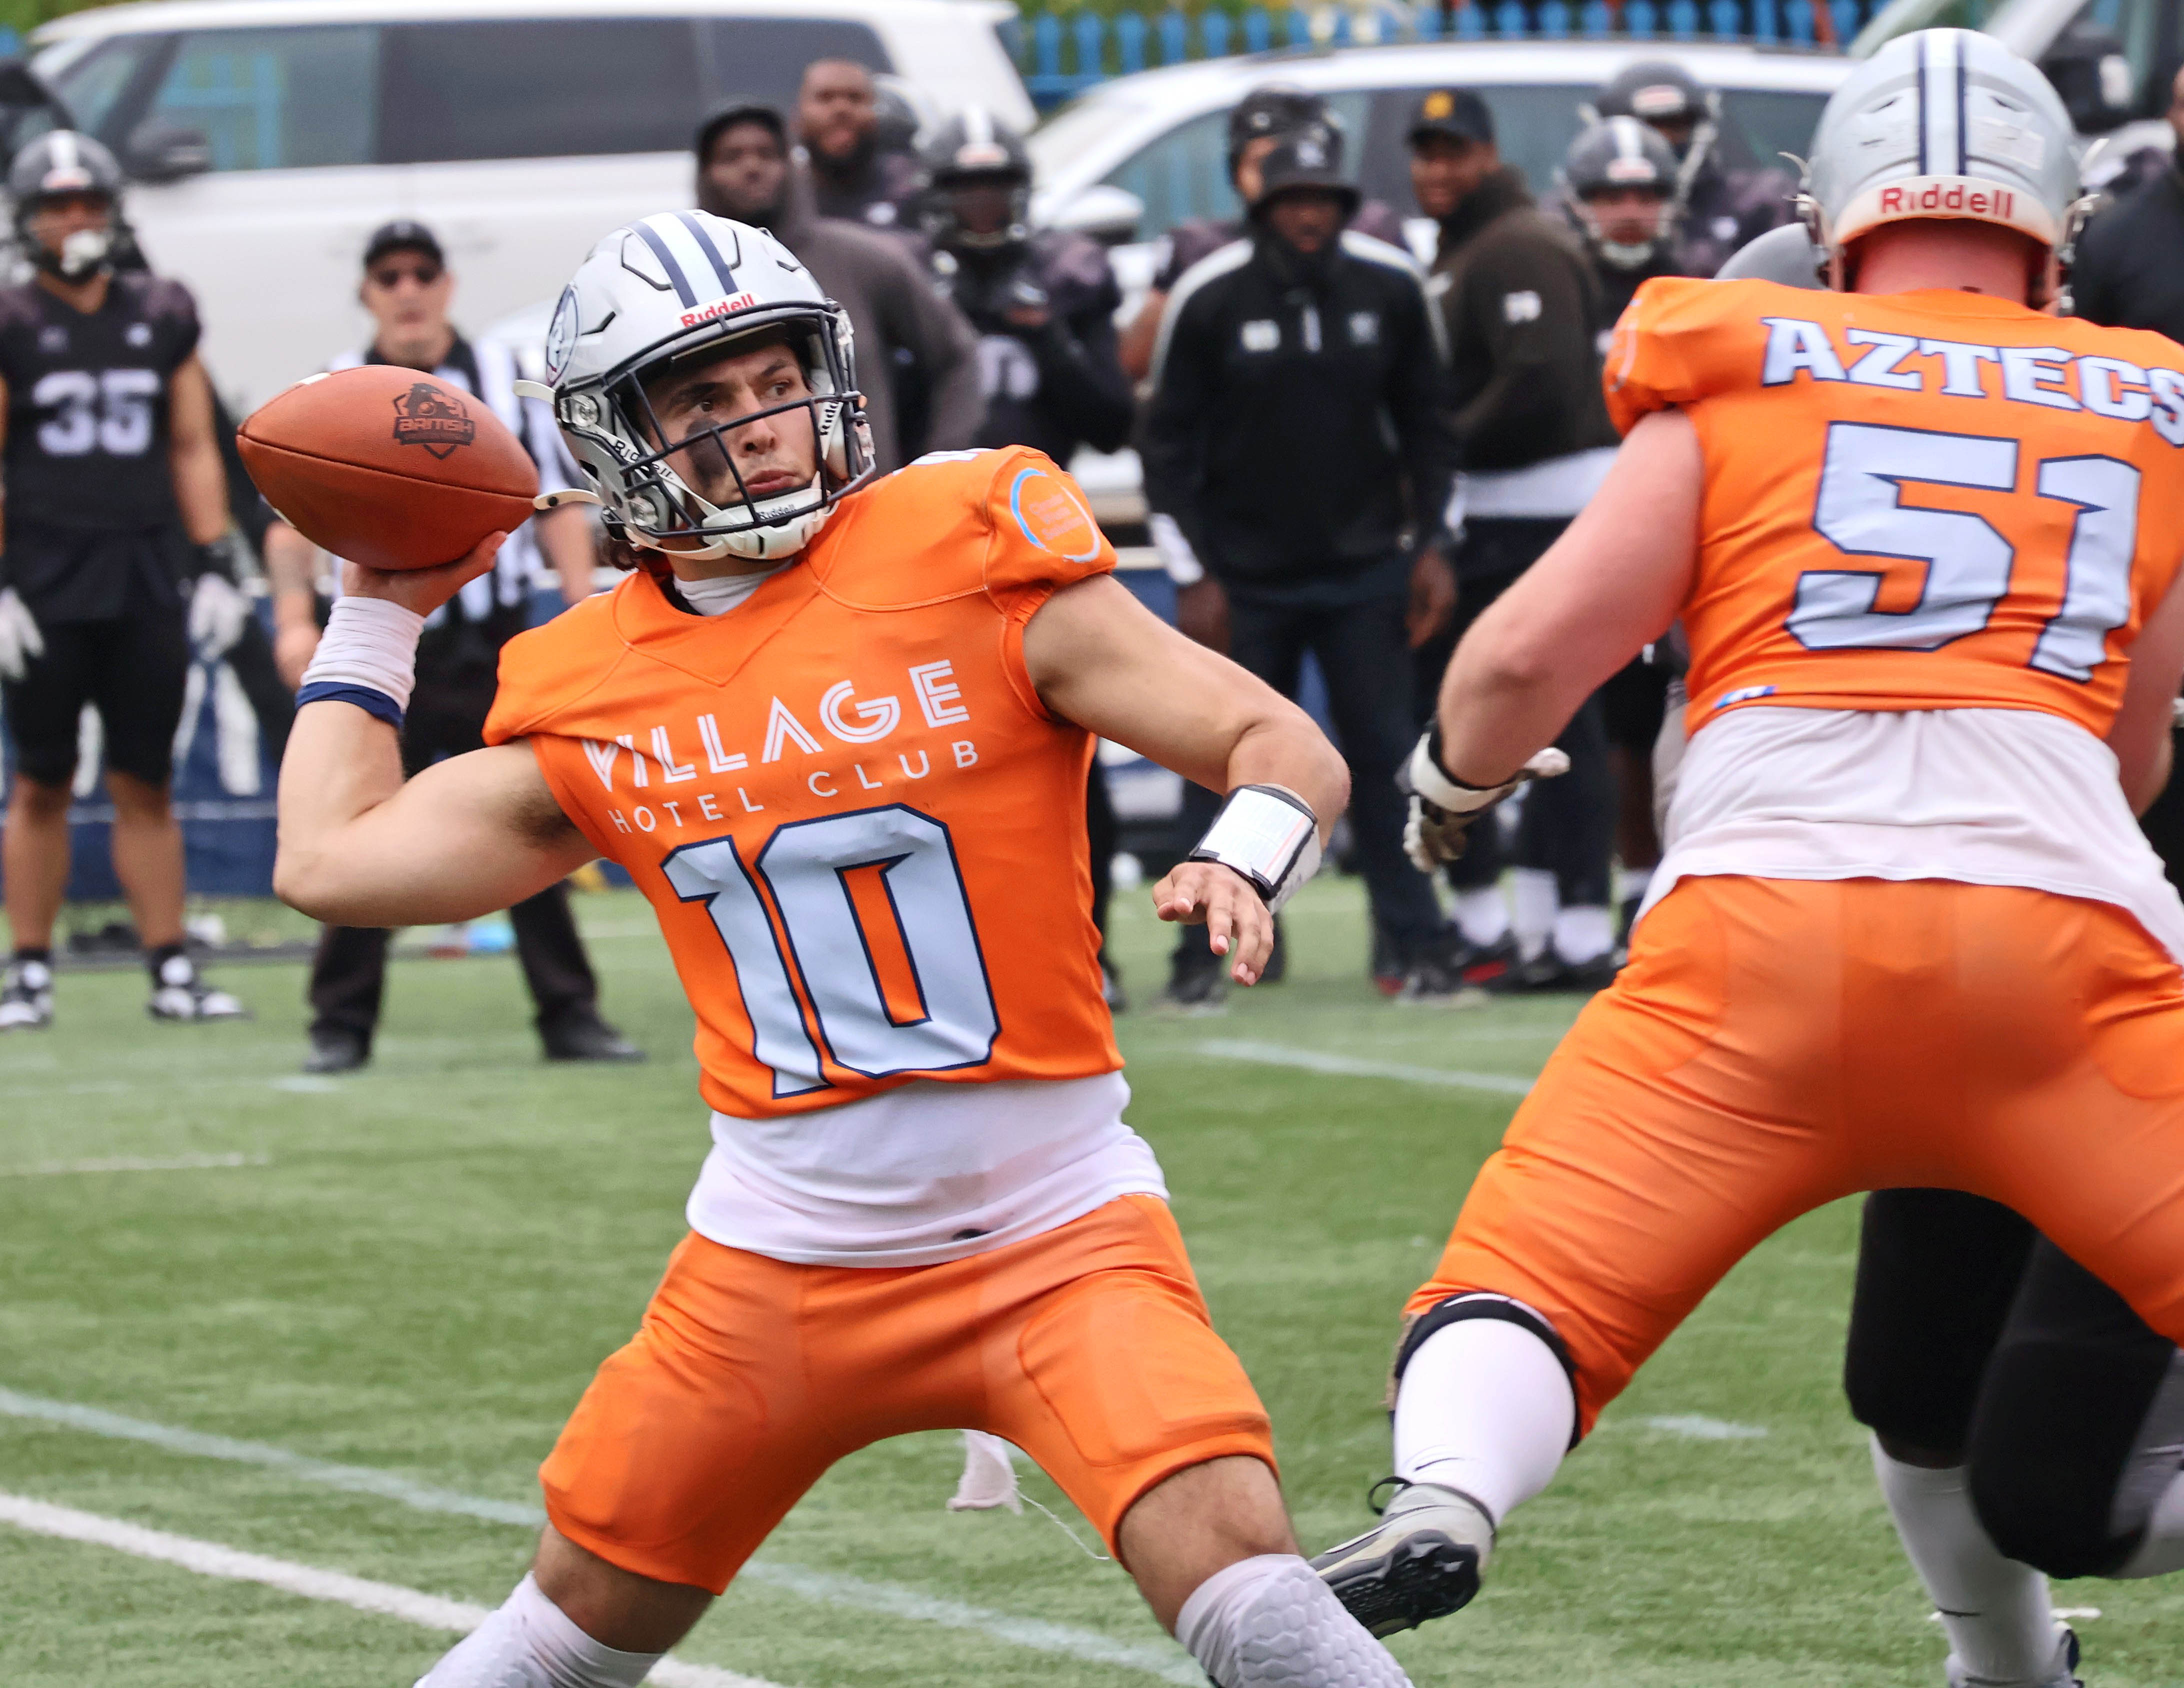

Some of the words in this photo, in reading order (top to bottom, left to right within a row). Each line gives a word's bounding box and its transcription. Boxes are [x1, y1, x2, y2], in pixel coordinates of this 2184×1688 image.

[1880, 183, 2016, 219] Riddell
[680, 293, 757, 328] Riddell
[33, 369, 162, 457] 35
[1760, 316, 2184, 449] AZTECS
[1784, 420, 2142, 684] 51
[581, 659, 970, 792] VILLAGE
[608, 787, 764, 834] HOTEL
[808, 739, 980, 797] CLUB
[660, 802, 1002, 1099] 10
